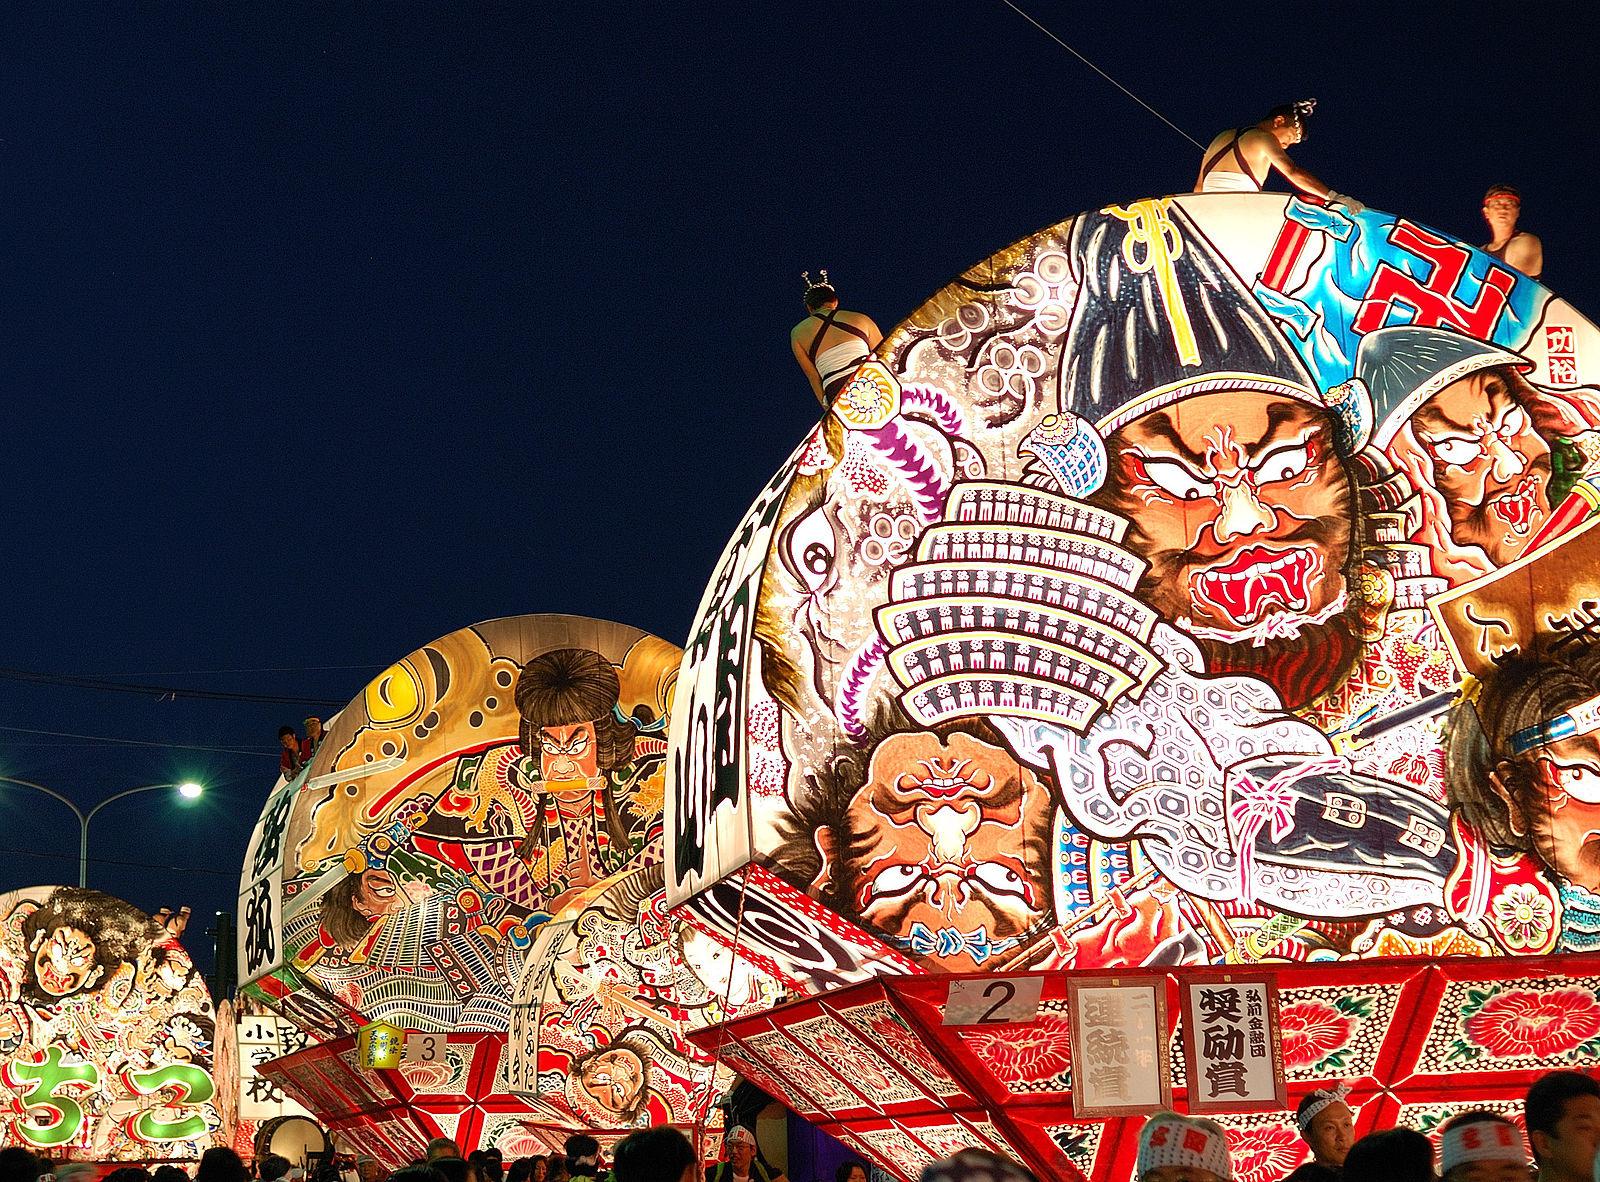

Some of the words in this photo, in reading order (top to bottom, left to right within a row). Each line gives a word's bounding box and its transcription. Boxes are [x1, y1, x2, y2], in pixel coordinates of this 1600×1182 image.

[977, 981, 1015, 1024] 2
[246, 1023, 284, 1103] 小学校
[421, 1036, 436, 1061] 3
[1199, 987, 1250, 1098] 奨励賞
